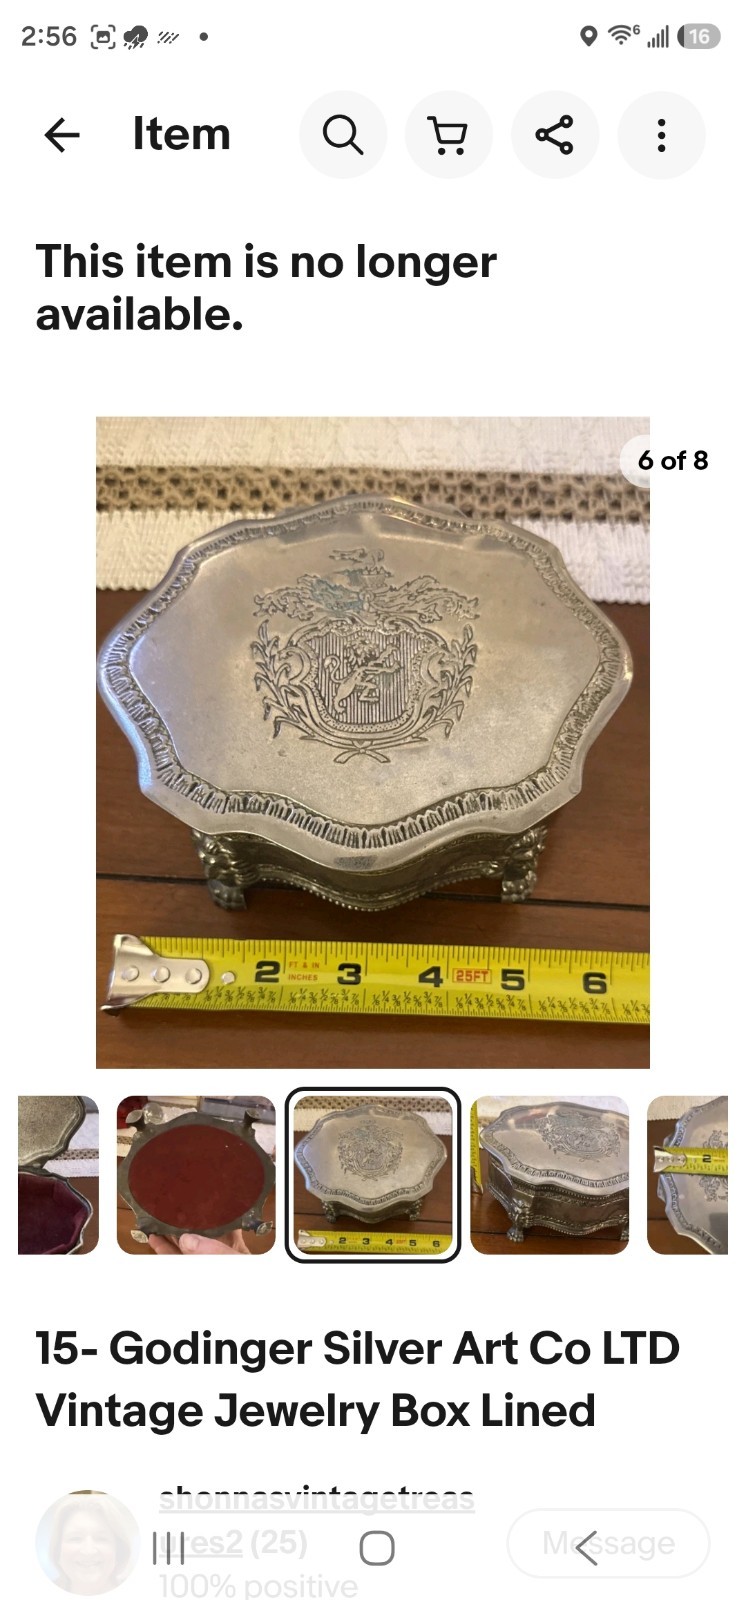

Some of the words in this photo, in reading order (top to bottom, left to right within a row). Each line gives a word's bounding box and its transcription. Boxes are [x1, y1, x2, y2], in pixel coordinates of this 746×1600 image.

[21, 26, 77, 47] 2:56
[689, 28, 710, 45] 16
[134, 115, 230, 151] Item
[36, 243, 124, 279] This
[136, 243, 231, 279] item
[244, 243, 279, 279] is
[291, 252, 344, 279] no
[357, 243, 498, 287] longer
[36, 295, 243, 331] available.
[638, 450, 654, 471] 6
[661, 450, 687, 471] of
[693, 450, 709, 471] 8
[254, 960, 281, 983] 2
[337, 962, 362, 986] 3
[418, 965, 444, 988] 4
[456, 969, 489, 982] 25FT
[501, 968, 525, 991] 5
[582, 972, 608, 995] 6
[35, 1330, 98, 1365] 15-
[109, 1329, 313, 1374] Godinger
[323, 1329, 443, 1365] Silver
[452, 1330, 519, 1365] Art
[529, 1330, 591, 1365] Co
[603, 1330, 680, 1365] LTD
[35, 1391, 204, 1436] Vintage
[214, 1392, 381, 1435] Jewelry
[392, 1392, 471, 1428] Box
[482, 1391, 595, 1428] Lined
[159, 1485, 476, 1516] shonnasvintagetreas
[250, 1529, 308, 1560] (25)
[543, 1530, 676, 1562] Message
[159, 1573, 236, 1599] 100%
[244, 1573, 359, 1600] positive
